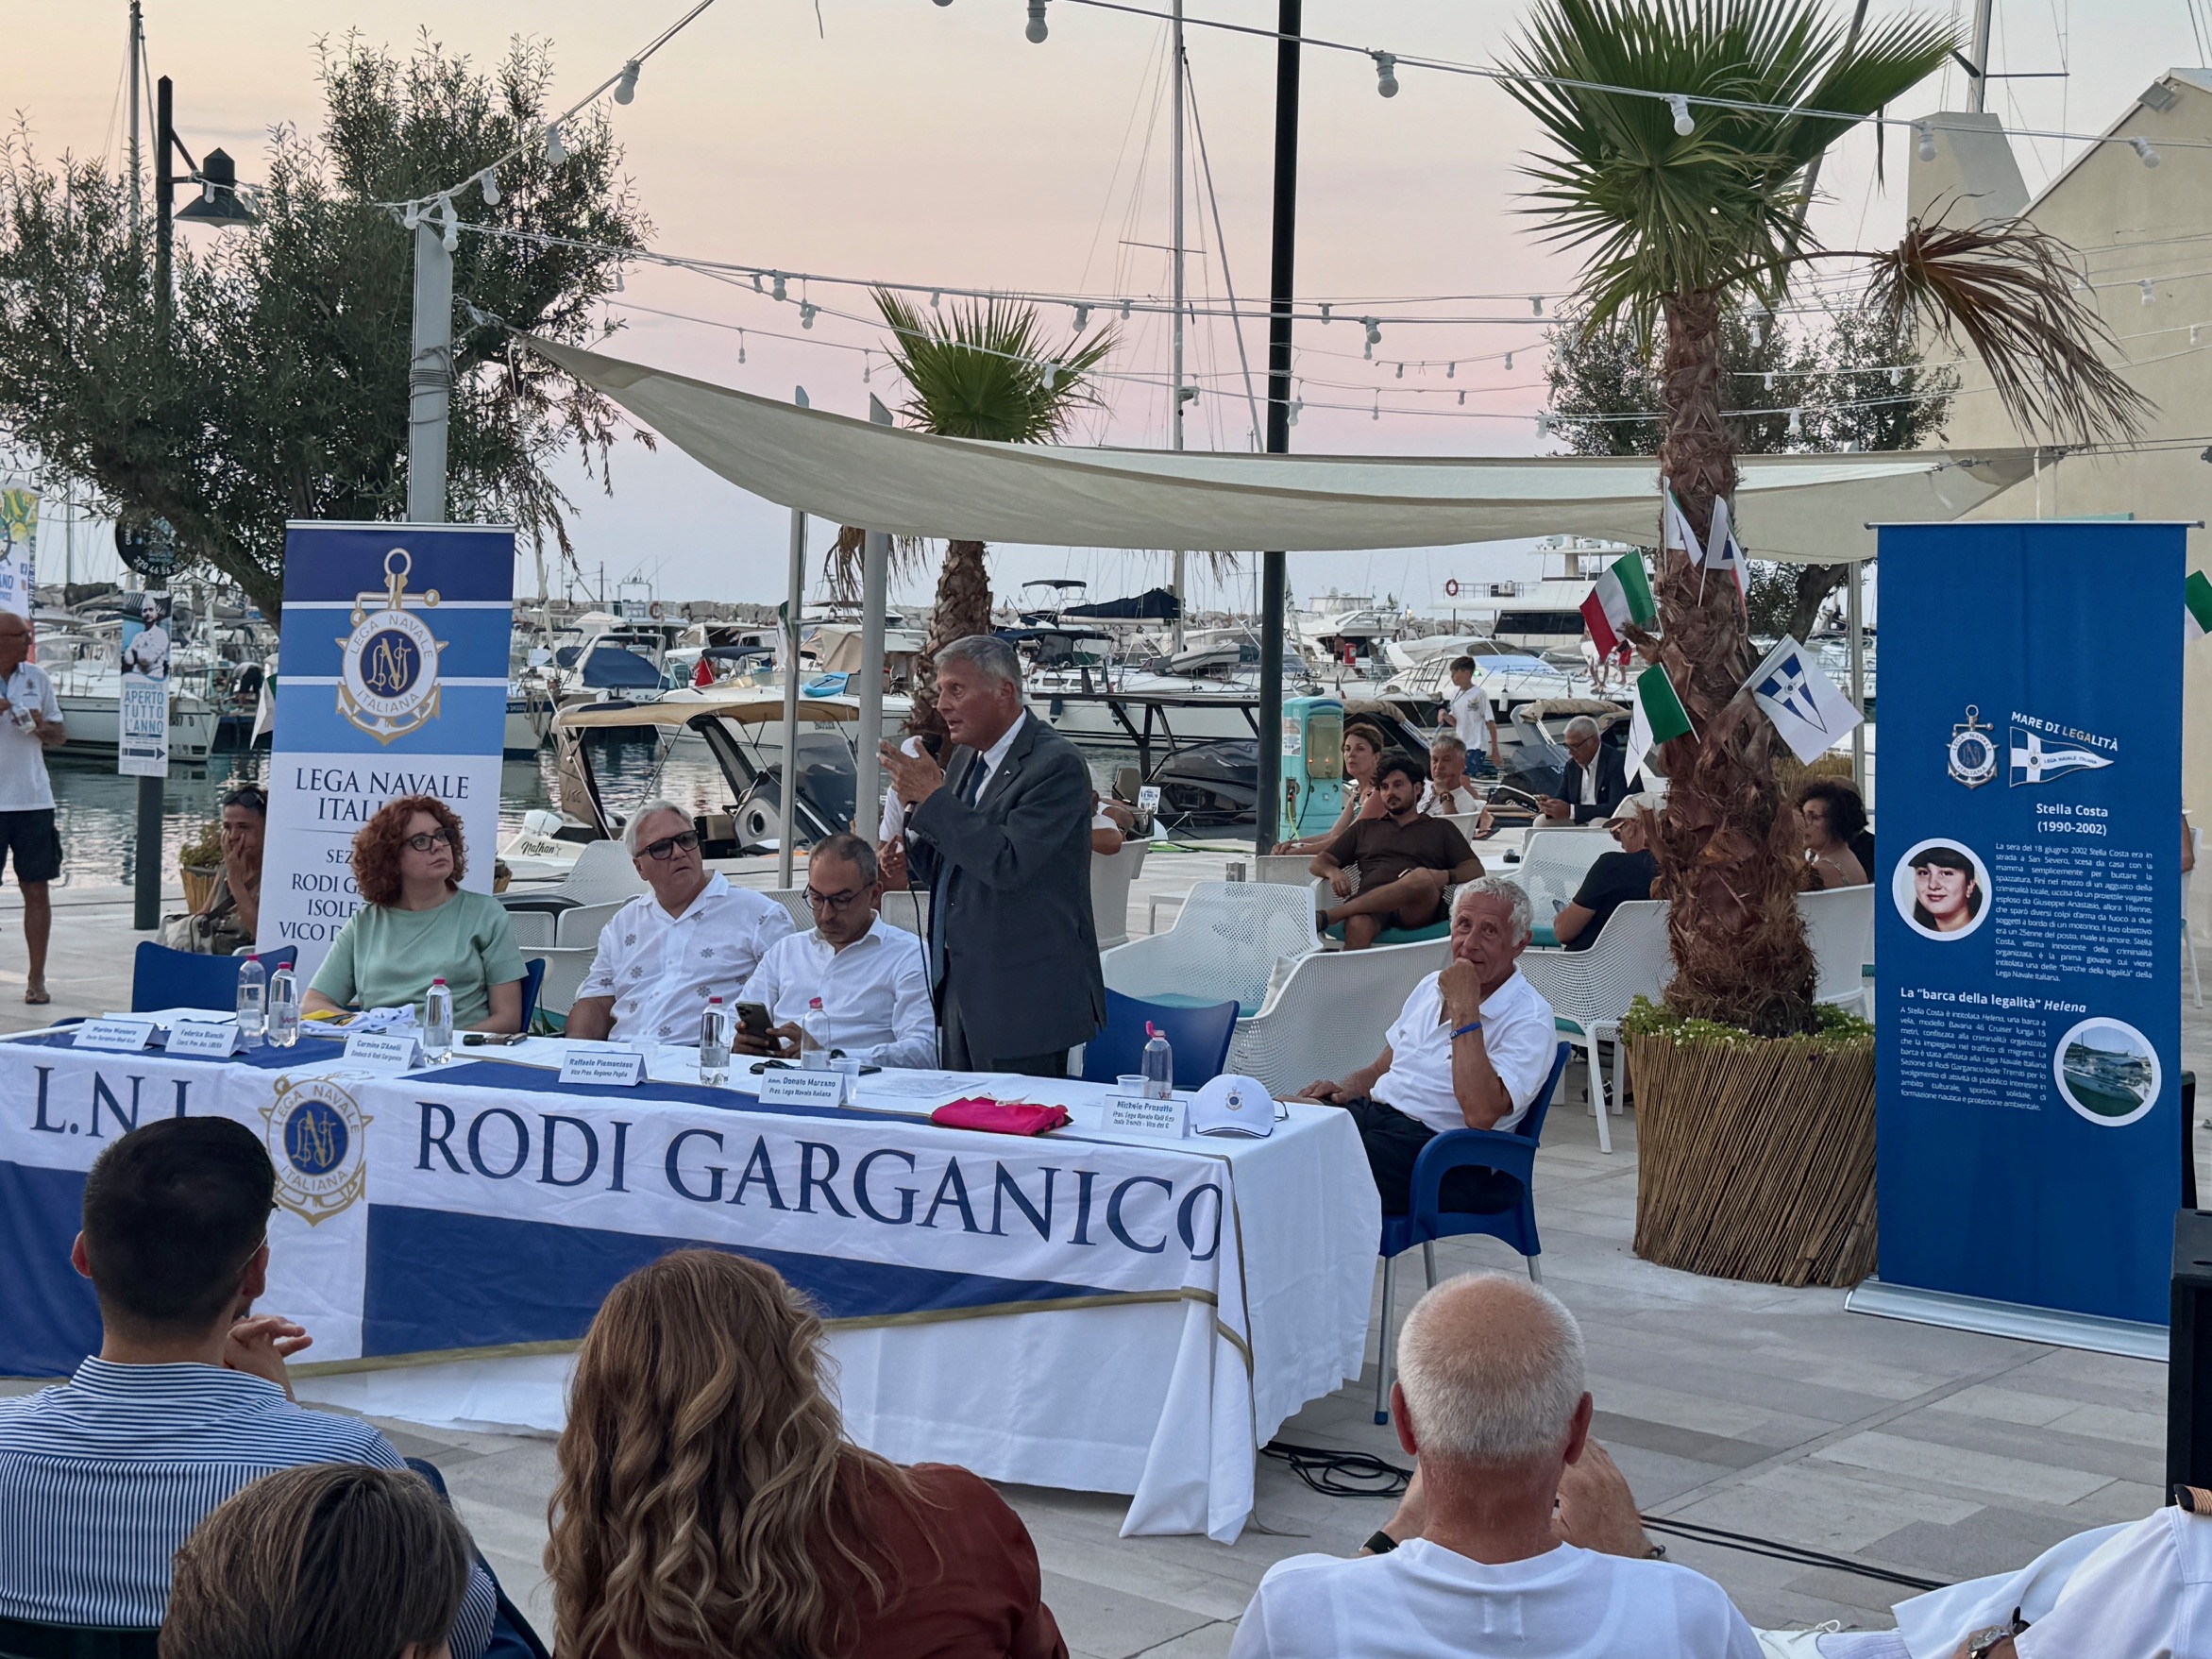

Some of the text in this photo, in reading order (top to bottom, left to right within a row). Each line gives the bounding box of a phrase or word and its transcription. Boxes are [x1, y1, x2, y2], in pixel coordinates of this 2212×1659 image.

[349, 614, 433, 659] LEGA NAVALE
[125, 691, 163, 704] APERTO
[357, 690, 420, 714] ITALIANA
[125, 704, 163, 719] TUTTO
[125, 719, 163, 733] L'ANNO
[2011, 711, 2119, 752] MARE DI LEGALITÀ
[1952, 733, 1992, 753] LEGA NAVALE
[1957, 765, 1986, 776] ITALIANA
[295, 768, 469, 800] LEGA NAVALE
[2035, 803, 2108, 817] Stella Costa
[2037, 821, 2107, 836] (1990-2002)
[521, 841, 554, 856] Nathan
[2044, 846, 2068, 855] giugno
[2070, 846, 2087, 855] 2002
[2089, 847, 2106, 855] Stella
[2031, 867, 2083, 875] semplicemente
[292, 873, 339, 892] RODI
[279, 921, 326, 941] VICO
[1900, 987, 1915, 998] La
[1958, 991, 1987, 1005] della
[2043, 1000, 2086, 1013] Helena
[783, 1076, 806, 1085] Donato
[807, 1078, 836, 1087] Marzano
[272, 1084, 360, 1134] LEGA NAVALE
[281, 1165, 349, 1192] ITALIANA
[414, 1101, 1223, 1261] RODI GARGANICO
